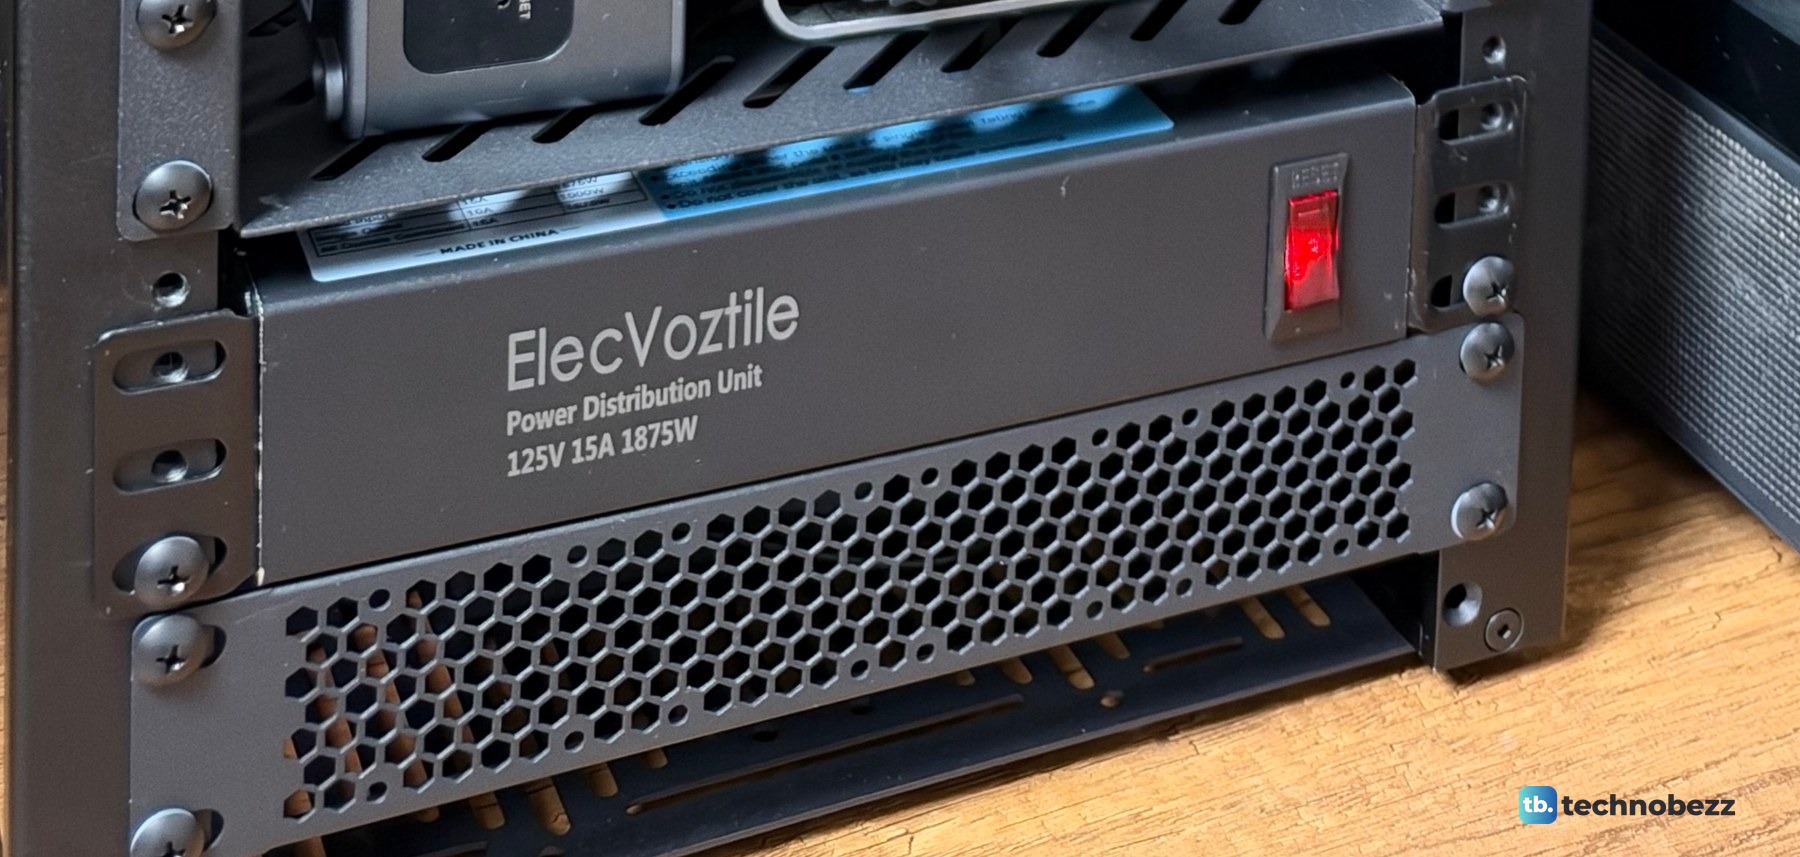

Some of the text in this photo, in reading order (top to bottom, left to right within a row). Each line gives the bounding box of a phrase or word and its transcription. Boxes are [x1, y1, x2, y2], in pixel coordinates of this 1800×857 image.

[440, 229, 559, 255] MADE IN CHINA
[507, 286, 800, 391] ElecVoztile
[507, 364, 763, 436] Power Distribution Unit
[507, 415, 698, 477] 125V 15A 1875W
